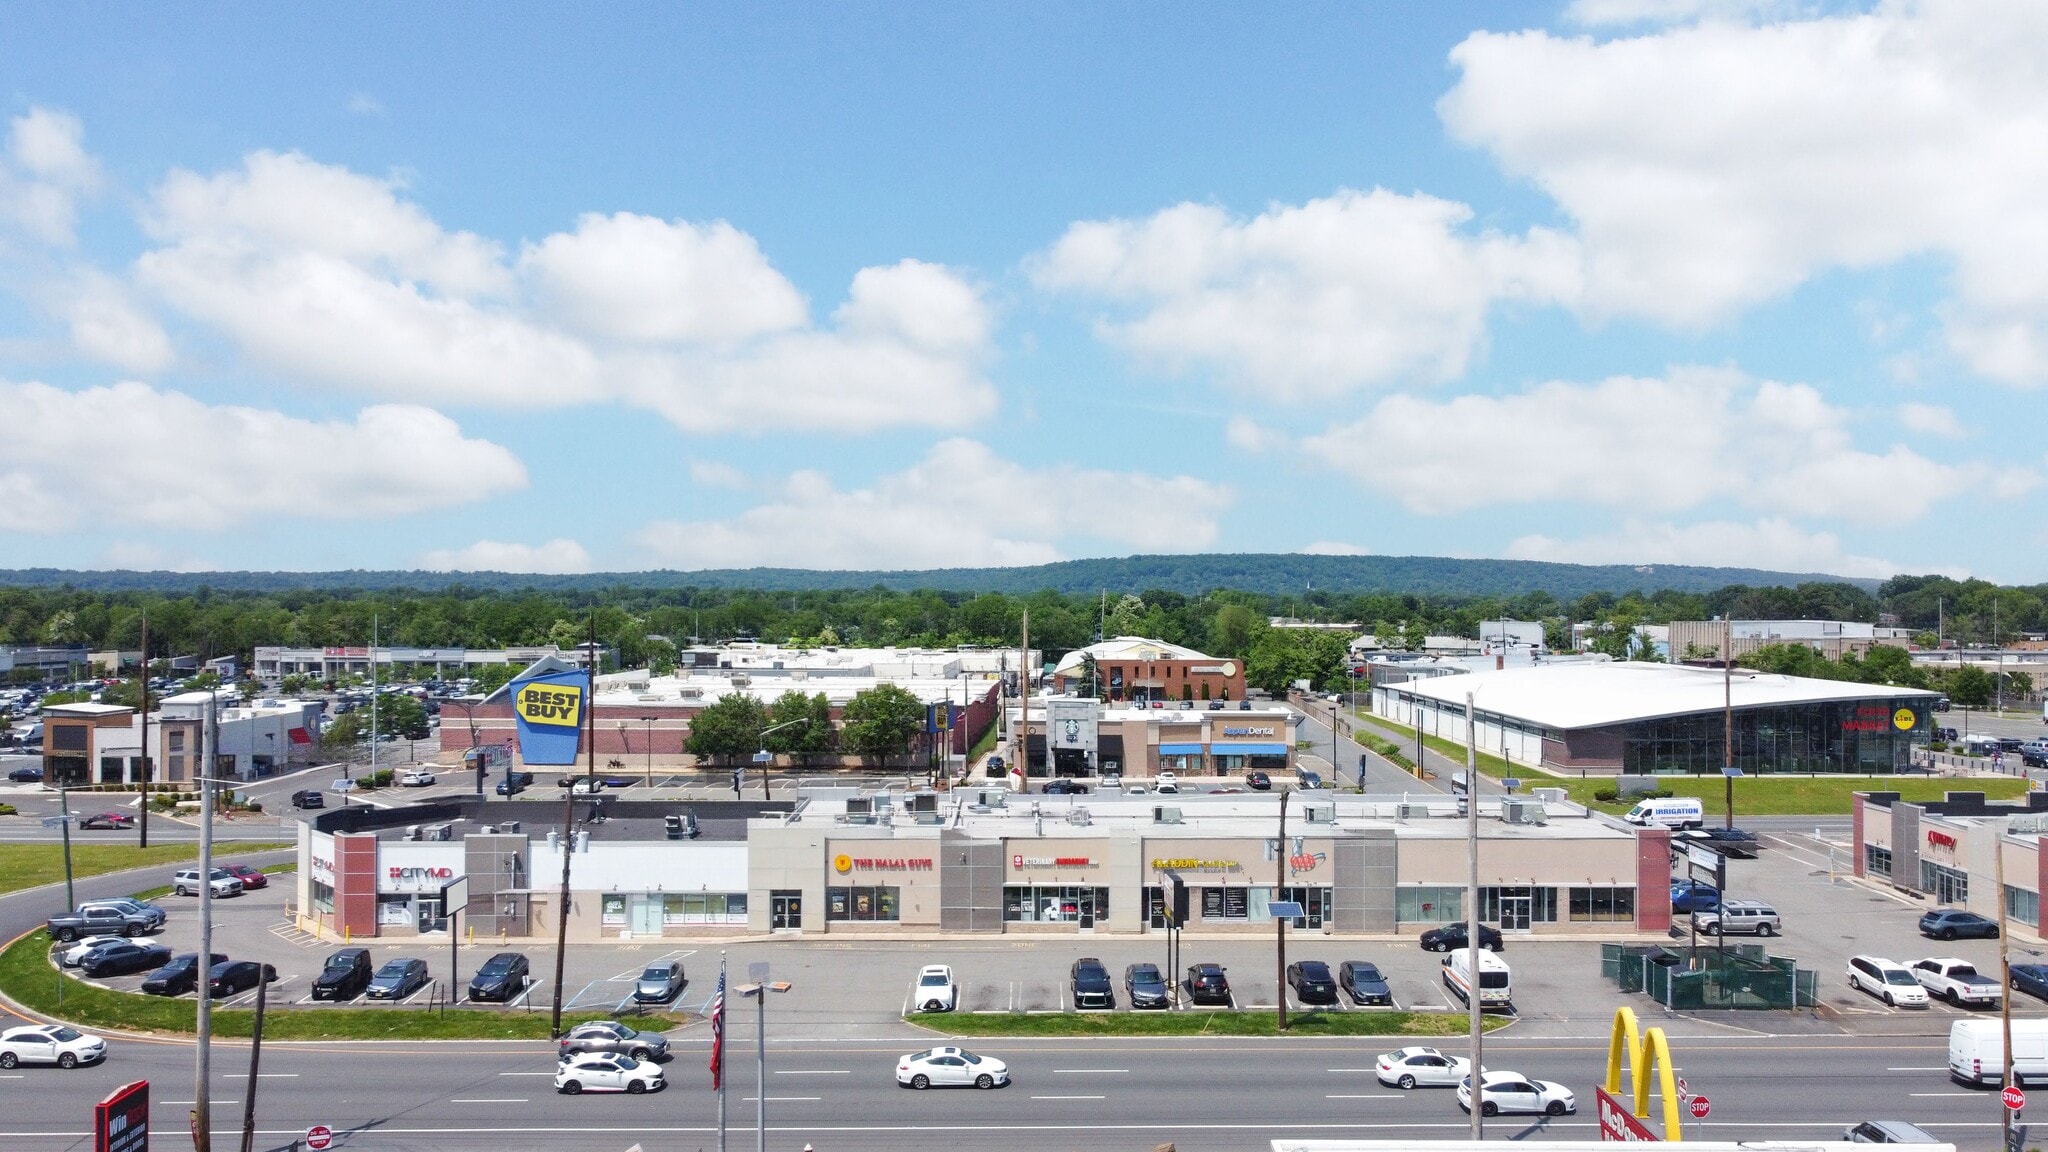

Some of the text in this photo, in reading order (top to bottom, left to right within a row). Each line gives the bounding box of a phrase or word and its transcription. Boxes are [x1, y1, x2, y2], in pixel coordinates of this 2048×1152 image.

[525, 690, 578, 706] BEST
[526, 704, 573, 719] BUY
[1857, 706, 1890, 716] FOOD
[1842, 720, 1890, 731] MARKET
[853, 859, 932, 868] THE HALAL GUYS
[400, 867, 453, 878] CITYMD
[2003, 1092, 2023, 1104] STOP
[1691, 1103, 1709, 1111] STOP
